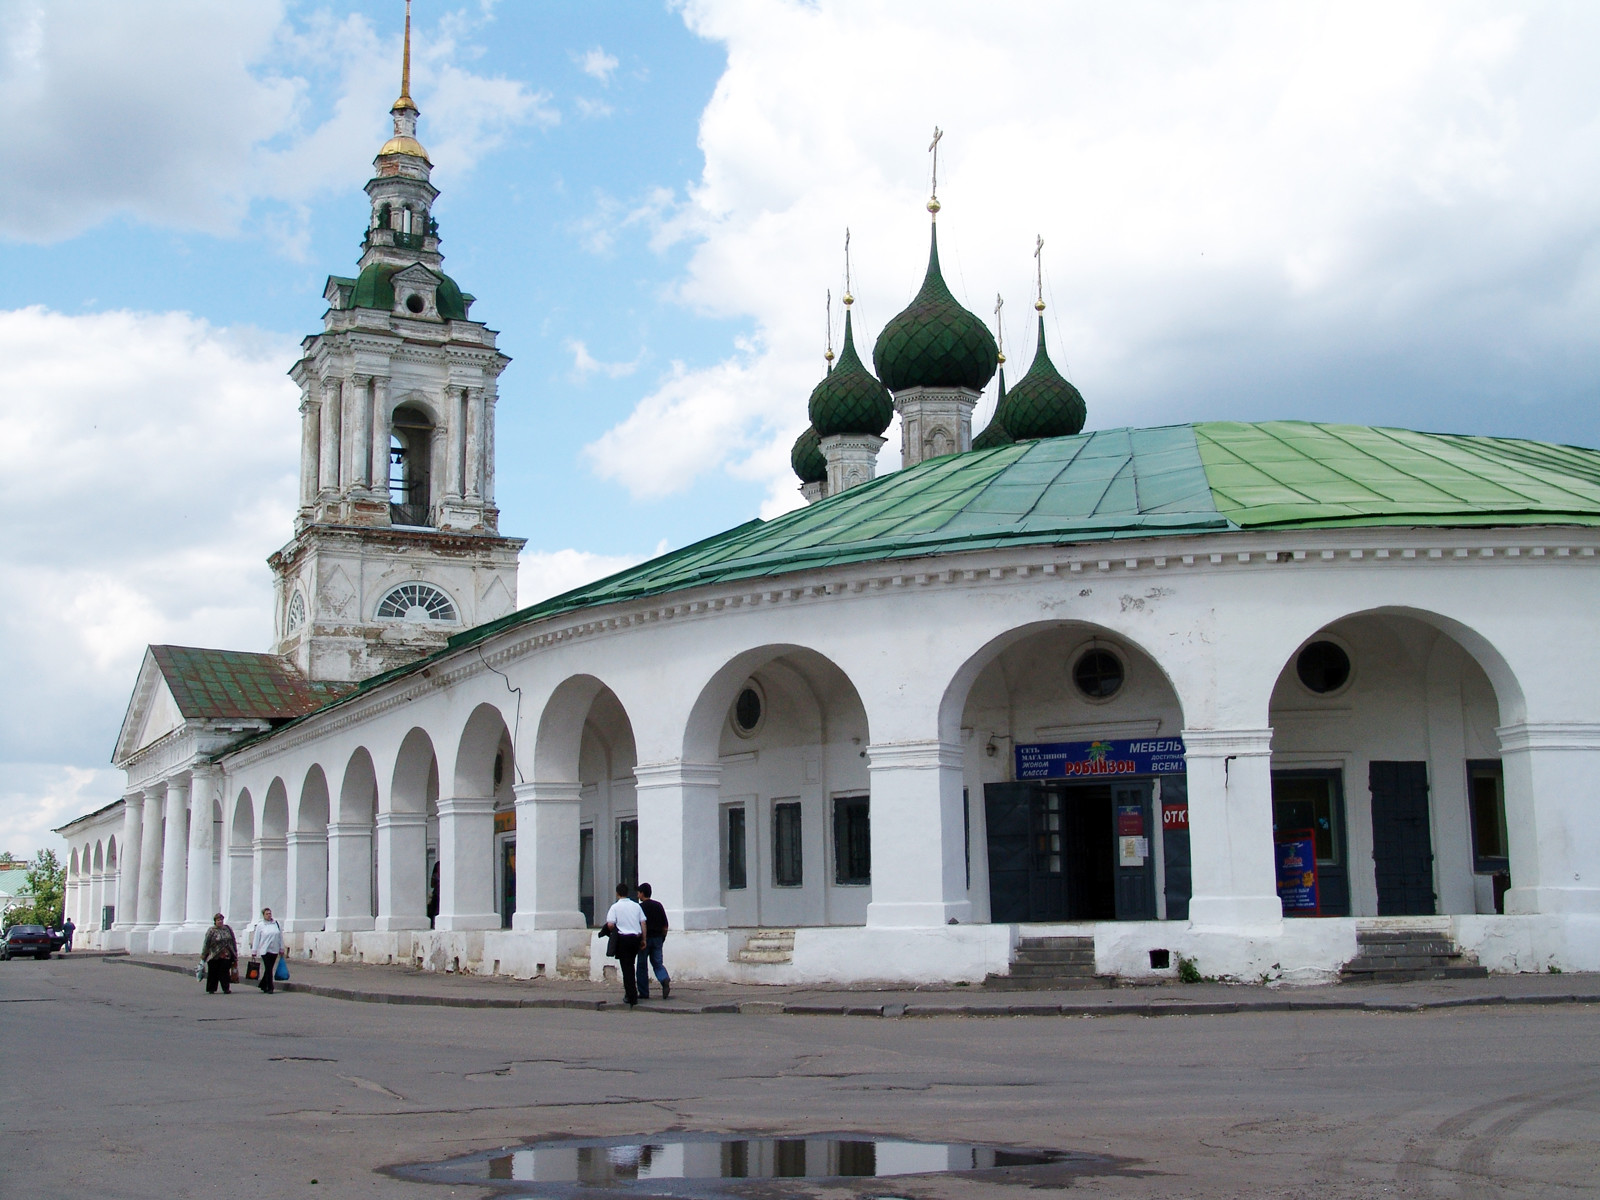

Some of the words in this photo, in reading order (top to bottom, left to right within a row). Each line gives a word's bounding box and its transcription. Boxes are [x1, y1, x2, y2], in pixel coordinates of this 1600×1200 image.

[1129, 741, 1182, 753] МЕБЕЛЬ
[1065, 758, 1136, 776] РОБИНЗОН
[1151, 761, 1183, 771] ВСЕМ!
[1163, 810, 1190, 824] ОТК
